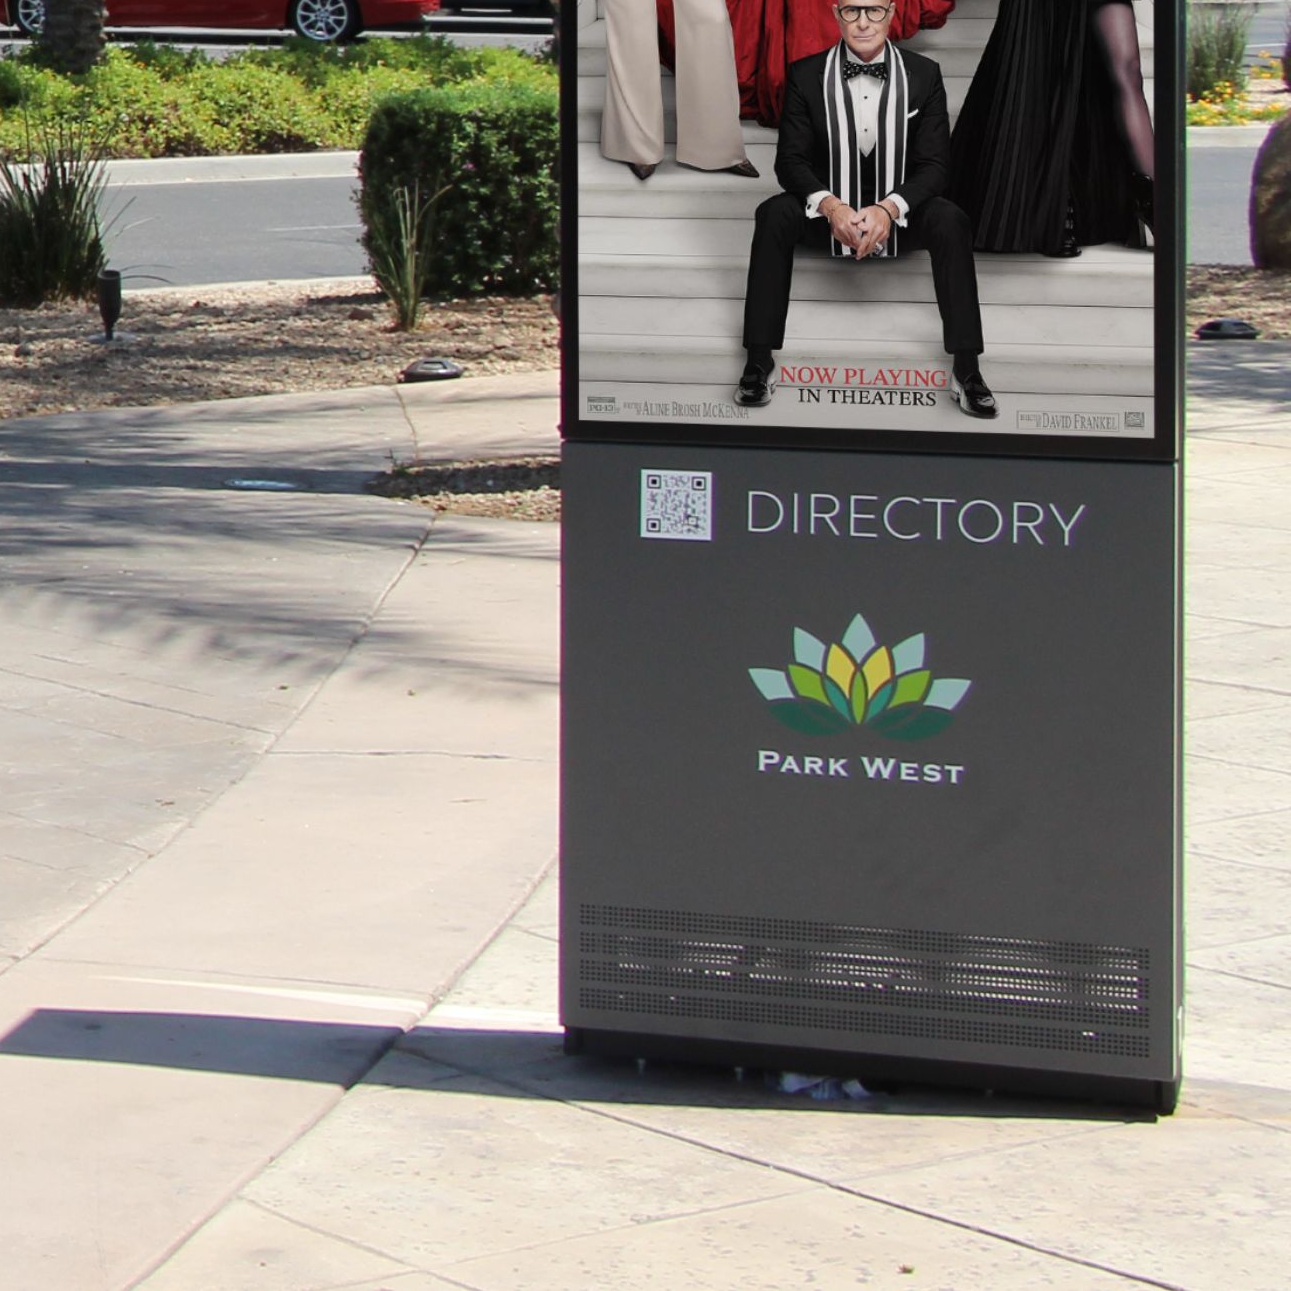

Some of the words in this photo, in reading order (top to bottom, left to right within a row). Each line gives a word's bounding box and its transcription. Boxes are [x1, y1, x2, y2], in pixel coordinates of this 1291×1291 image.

[780, 366, 837, 384] NOW
[844, 368, 947, 388] PLAYING
[798, 388, 821, 403] IN
[827, 389, 937, 407] THEATERS
[641, 401, 670, 417] ALINE
[672, 402, 701, 418] BROSH
[1042, 412, 1072, 429] DAVID
[1074, 413, 1117, 430] FRANKEL
[747, 490, 1086, 546] DIRECTORY
[758, 749, 848, 777] PARK
[860, 756, 964, 784] WEST
